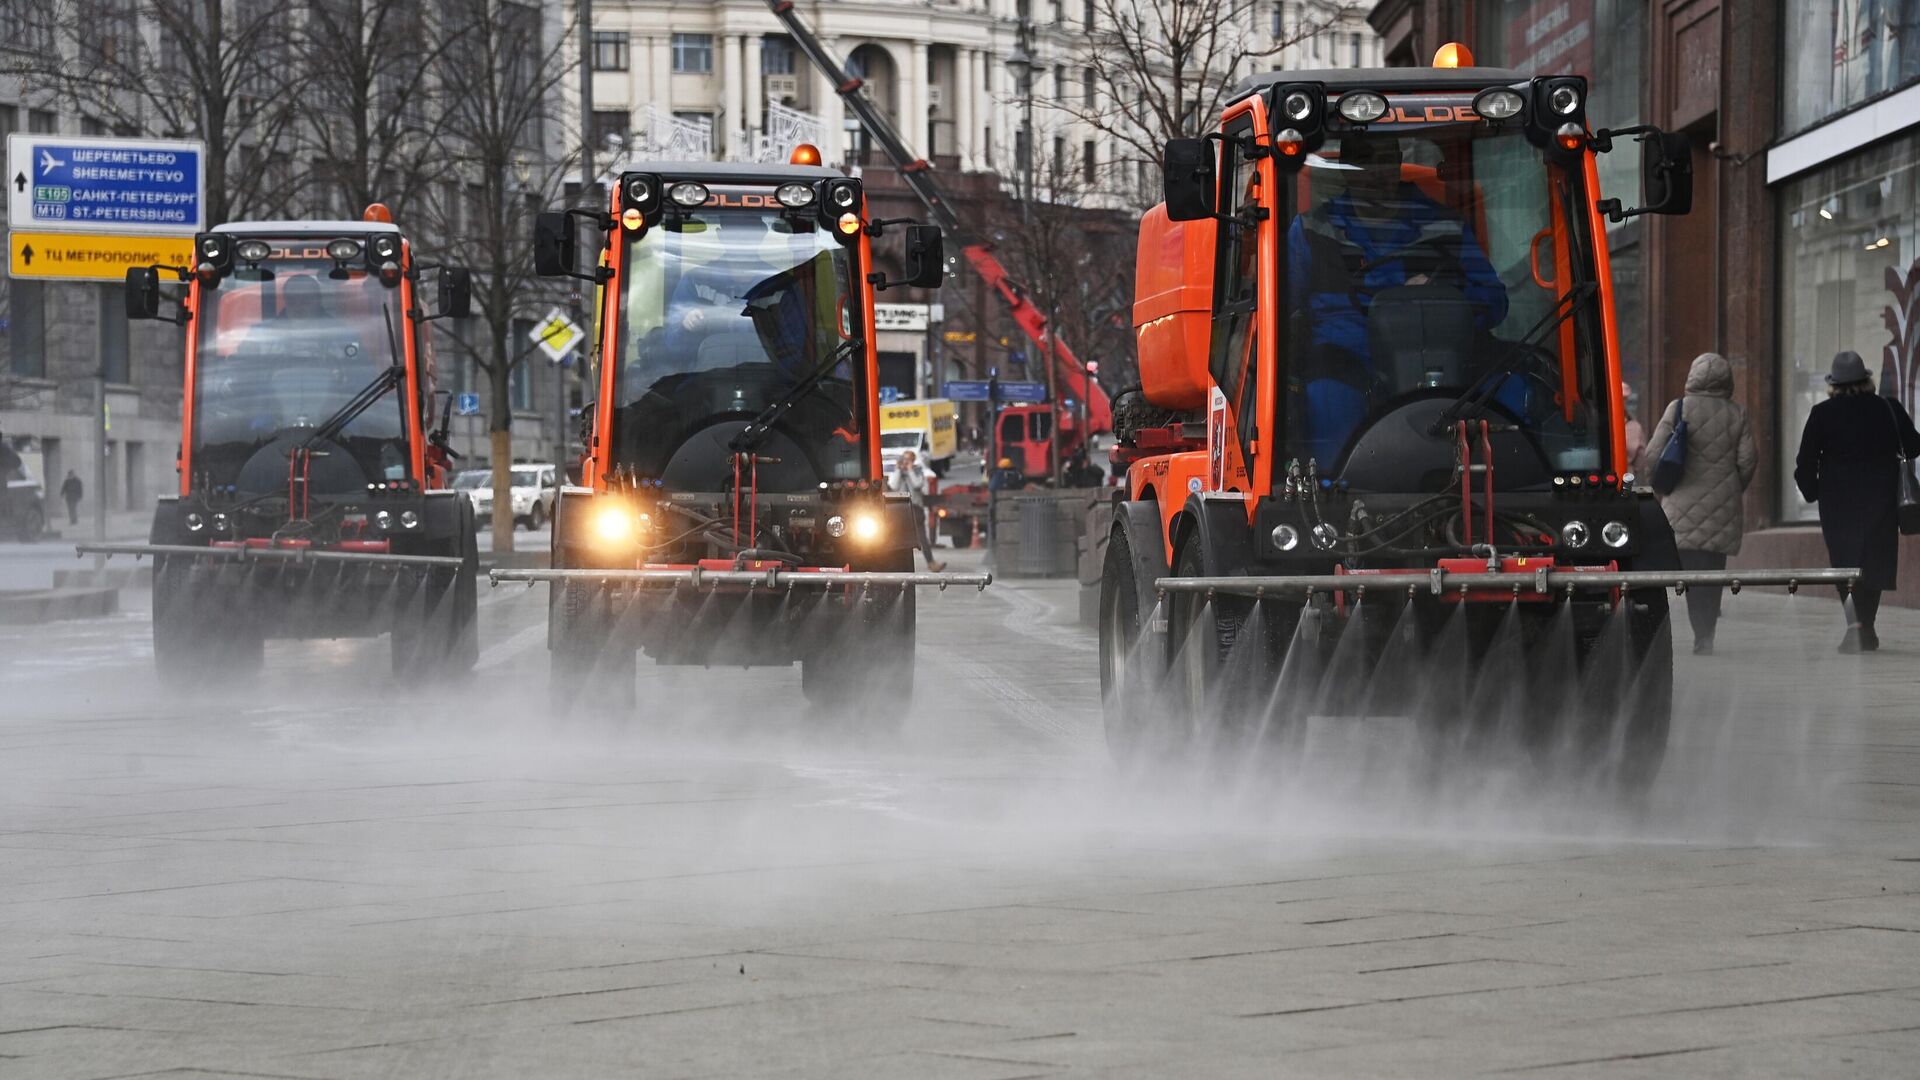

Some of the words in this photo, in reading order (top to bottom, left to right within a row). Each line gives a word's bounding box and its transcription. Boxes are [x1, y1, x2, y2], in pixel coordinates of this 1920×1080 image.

[1375, 106, 1484, 123] OLDE
[73, 150, 176, 165] ШЕРЕМЕТЬЕВО
[73, 189, 195, 204] САНКТ-ПЕТЕРБУРГ
[703, 194, 784, 208] OLDE
[38, 204, 63, 217] M10
[45, 249, 63, 262] ТЦ
[66, 250, 160, 264] МЕТРОПОЛИС
